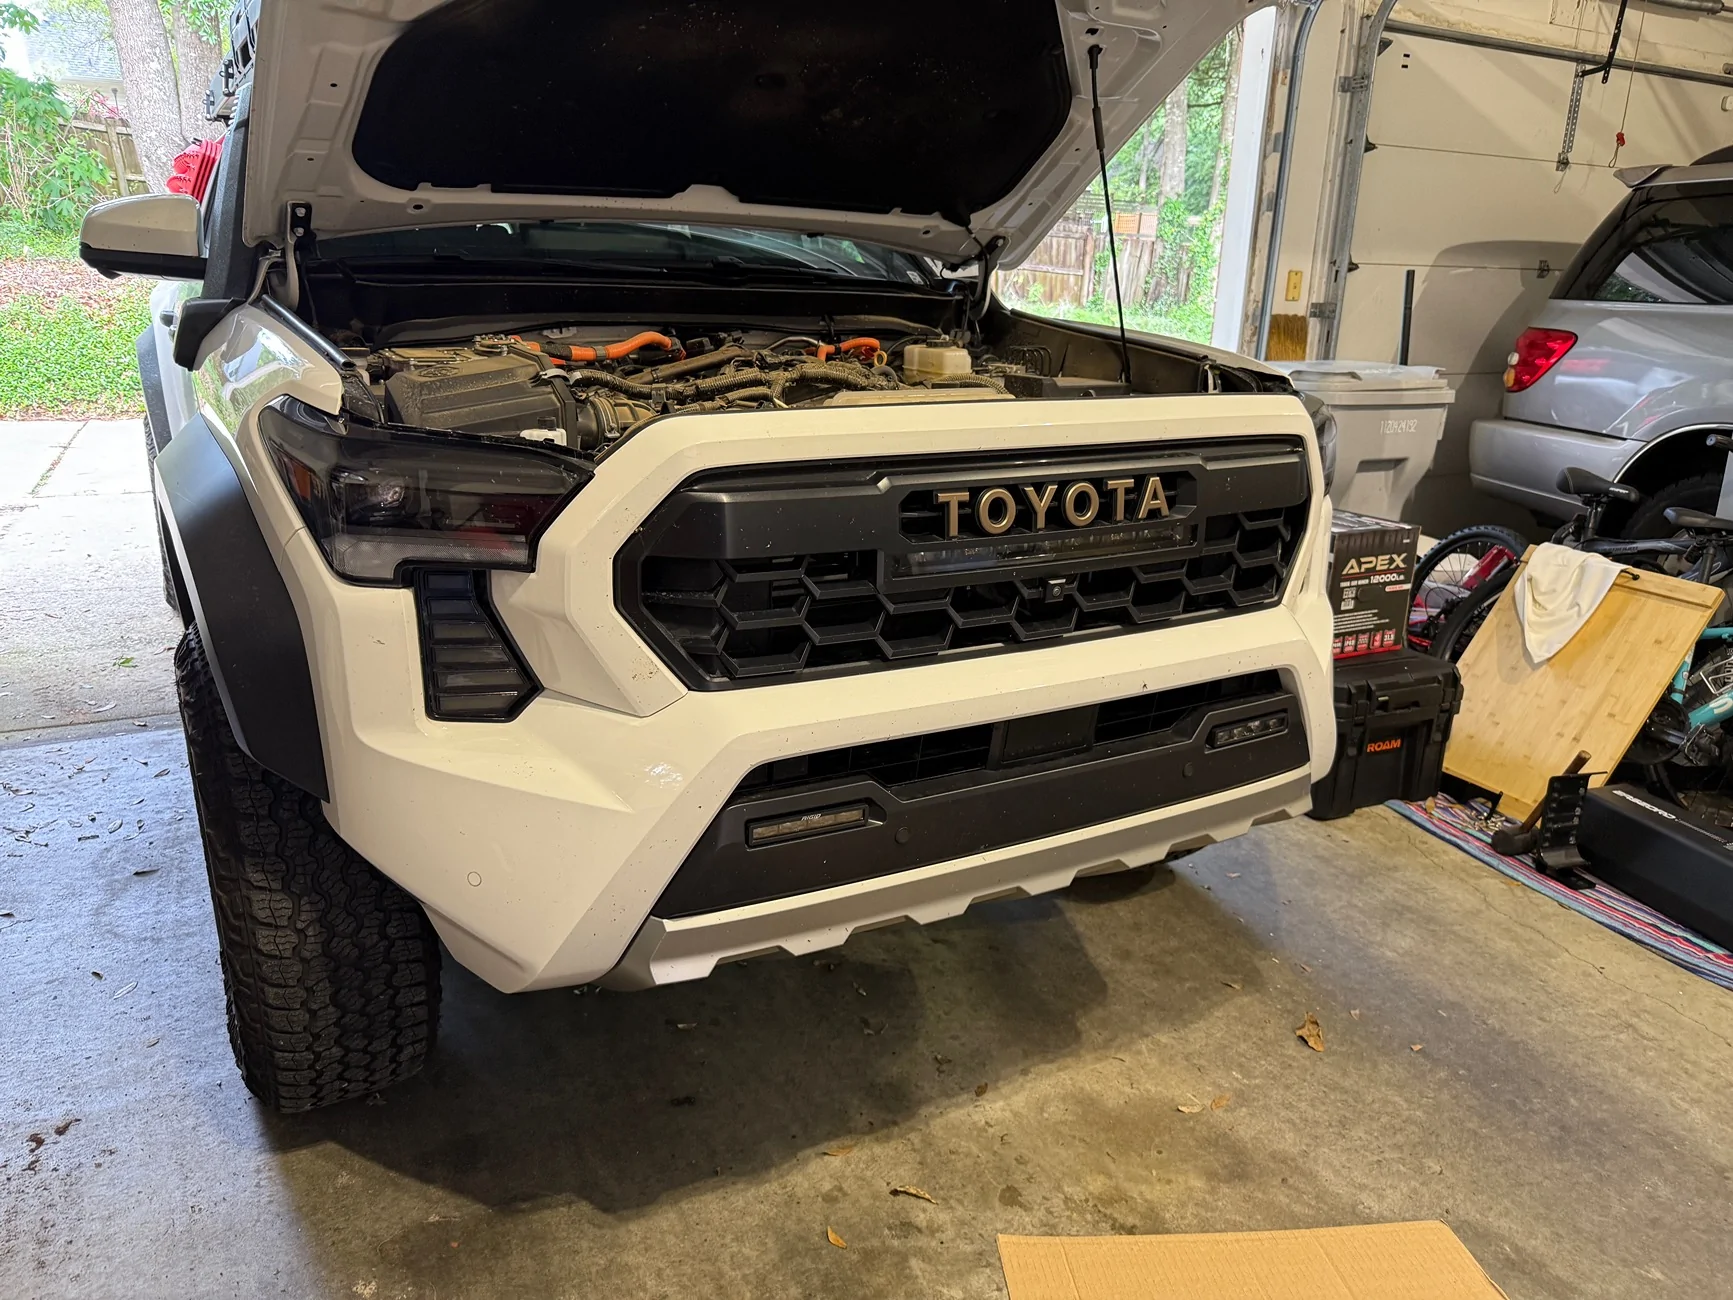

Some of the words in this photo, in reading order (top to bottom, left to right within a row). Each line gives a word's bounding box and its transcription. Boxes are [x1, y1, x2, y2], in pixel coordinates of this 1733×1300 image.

[935, 475, 1170, 538] TOYOTA
[1341, 553, 1407, 574] APEX
[1367, 739, 1401, 752] ROAM
